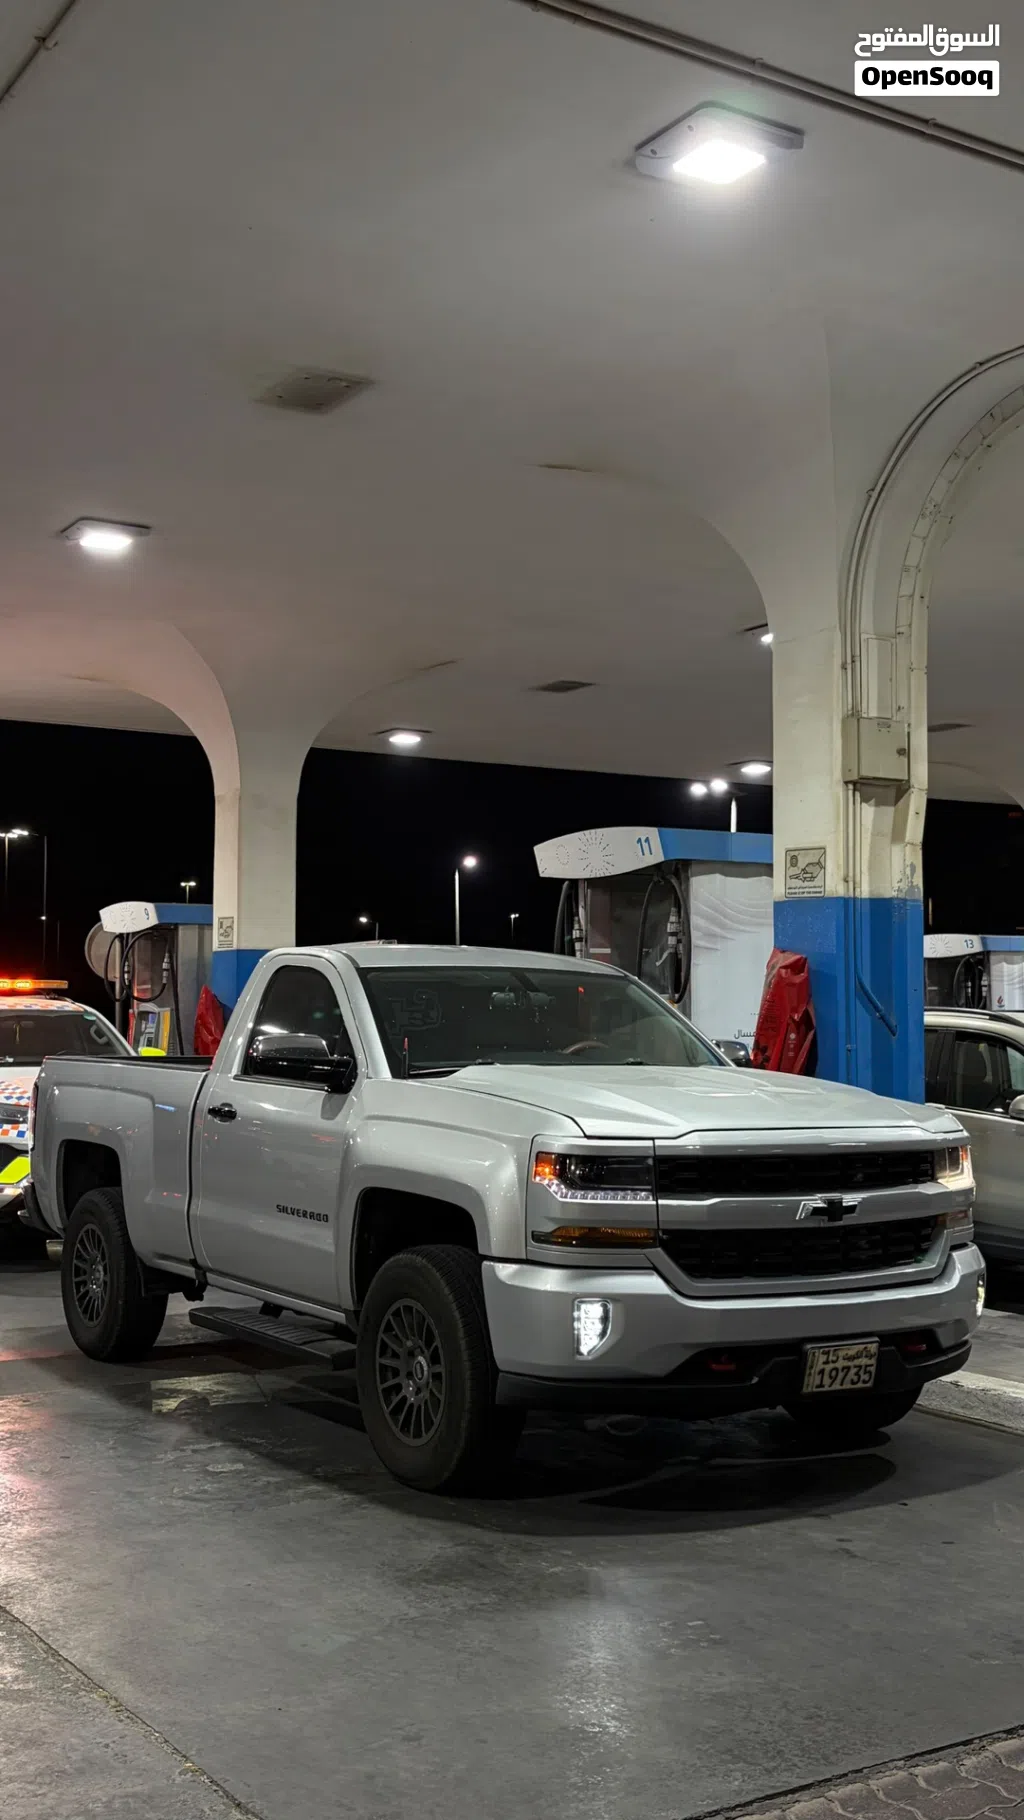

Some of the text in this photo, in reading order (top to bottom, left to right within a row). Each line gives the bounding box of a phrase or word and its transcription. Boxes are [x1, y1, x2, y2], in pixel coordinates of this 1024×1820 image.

[636, 836, 653, 856] 11
[963, 938, 975, 949] 13
[276, 1204, 329, 1223] SILVERADO
[814, 1363, 875, 1389] 19735
